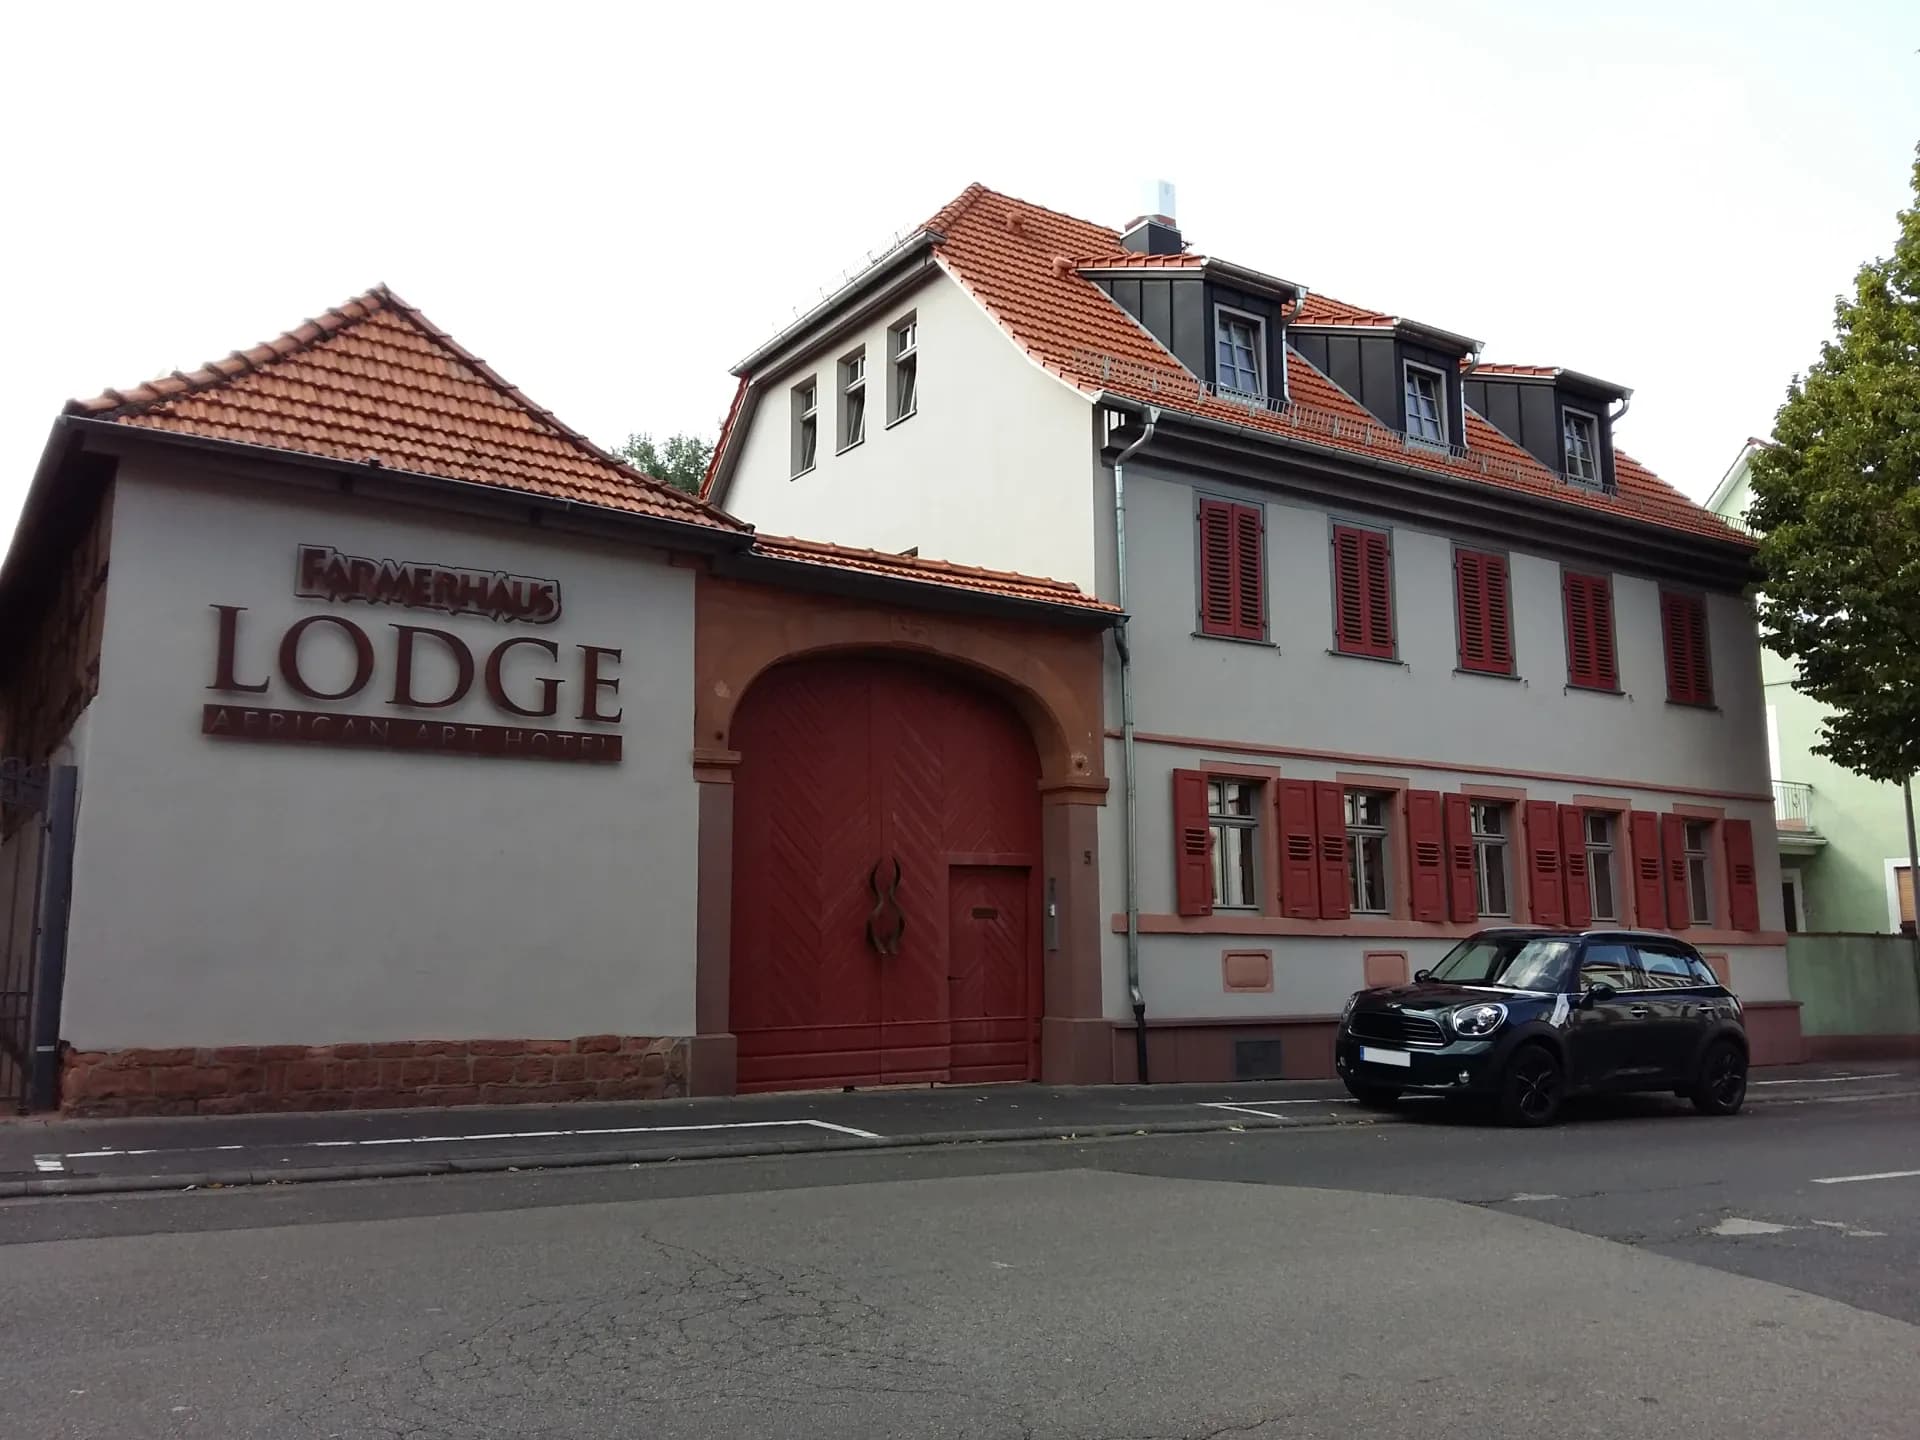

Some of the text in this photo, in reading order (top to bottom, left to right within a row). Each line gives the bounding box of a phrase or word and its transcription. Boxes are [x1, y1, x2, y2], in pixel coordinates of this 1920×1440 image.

[299, 547, 557, 618] FARMERHAUS
[206, 604, 624, 723] LODGE
[208, 707, 391, 741] AFRICAN
[415, 723, 484, 748] ART
